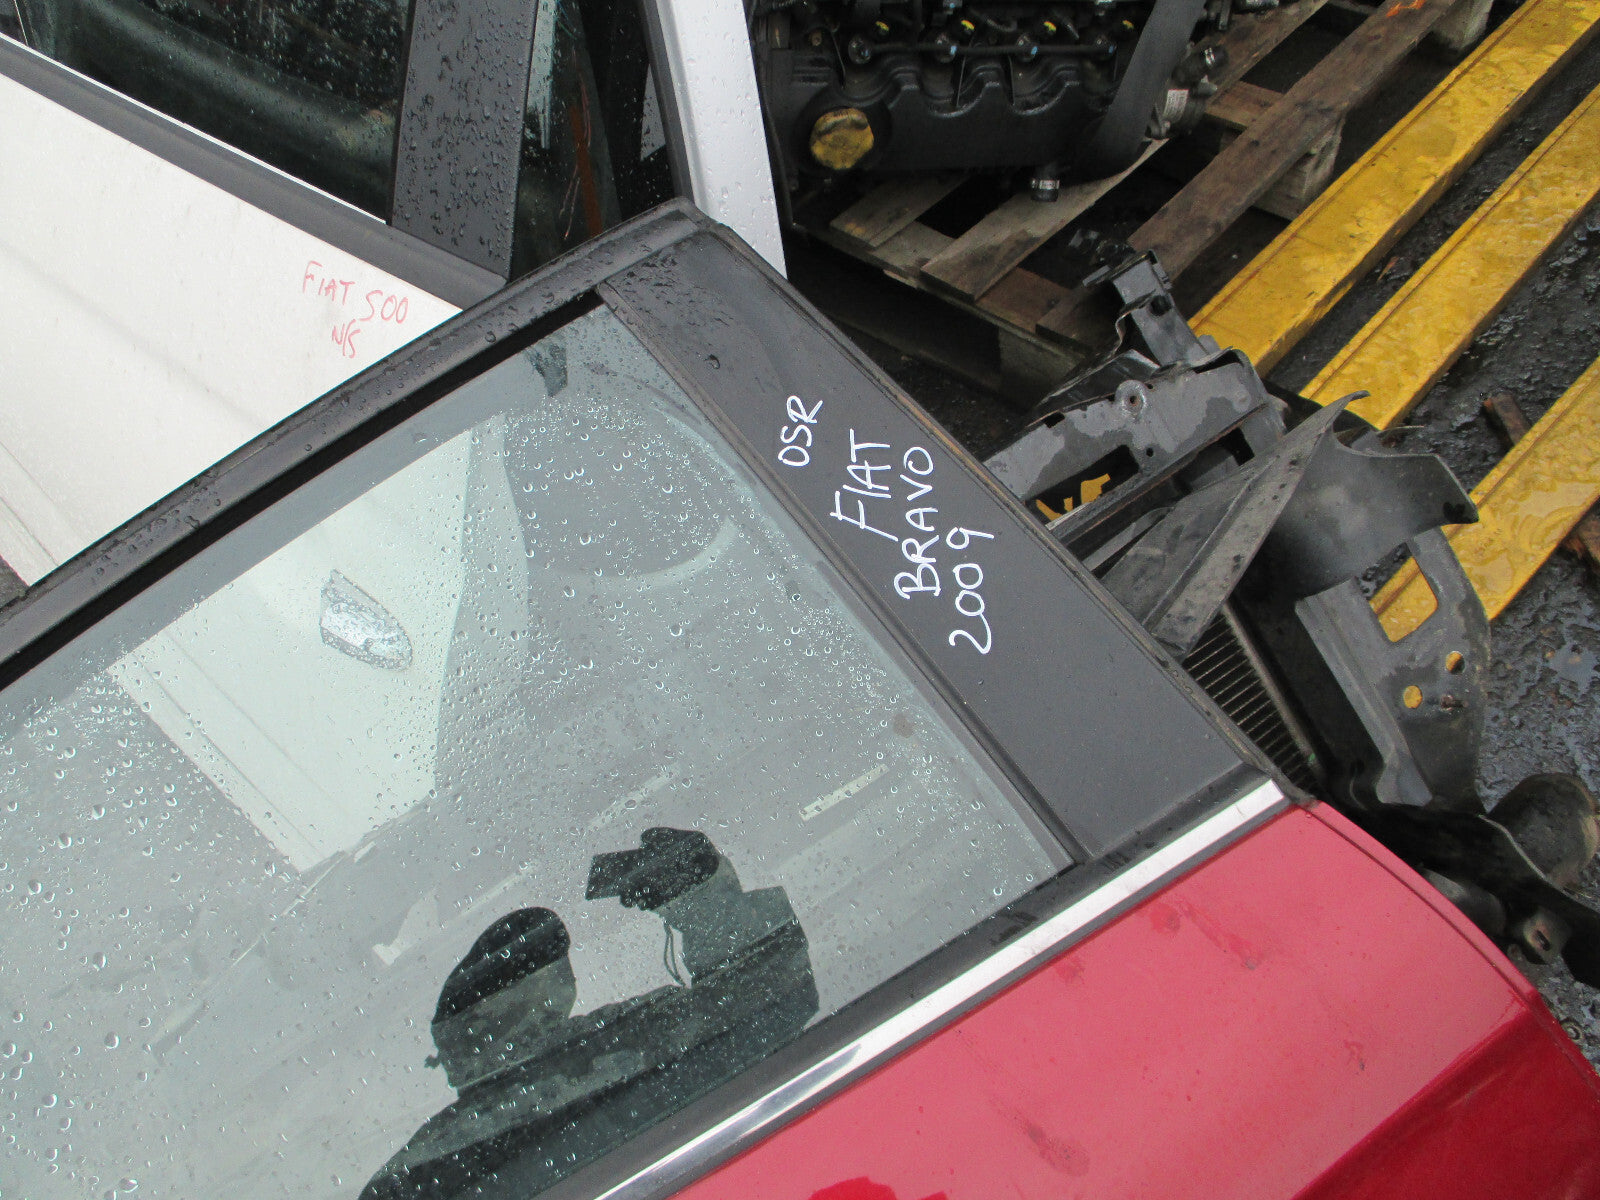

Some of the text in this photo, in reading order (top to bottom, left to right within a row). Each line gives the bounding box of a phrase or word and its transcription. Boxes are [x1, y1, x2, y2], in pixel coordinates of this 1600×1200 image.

[303, 261, 409, 324] FIAT 500
[778, 395, 823, 467] OSR
[830, 428, 899, 542] FIAT
[894, 446, 942, 600] BRAVO
[945, 527, 995, 655] 2009
